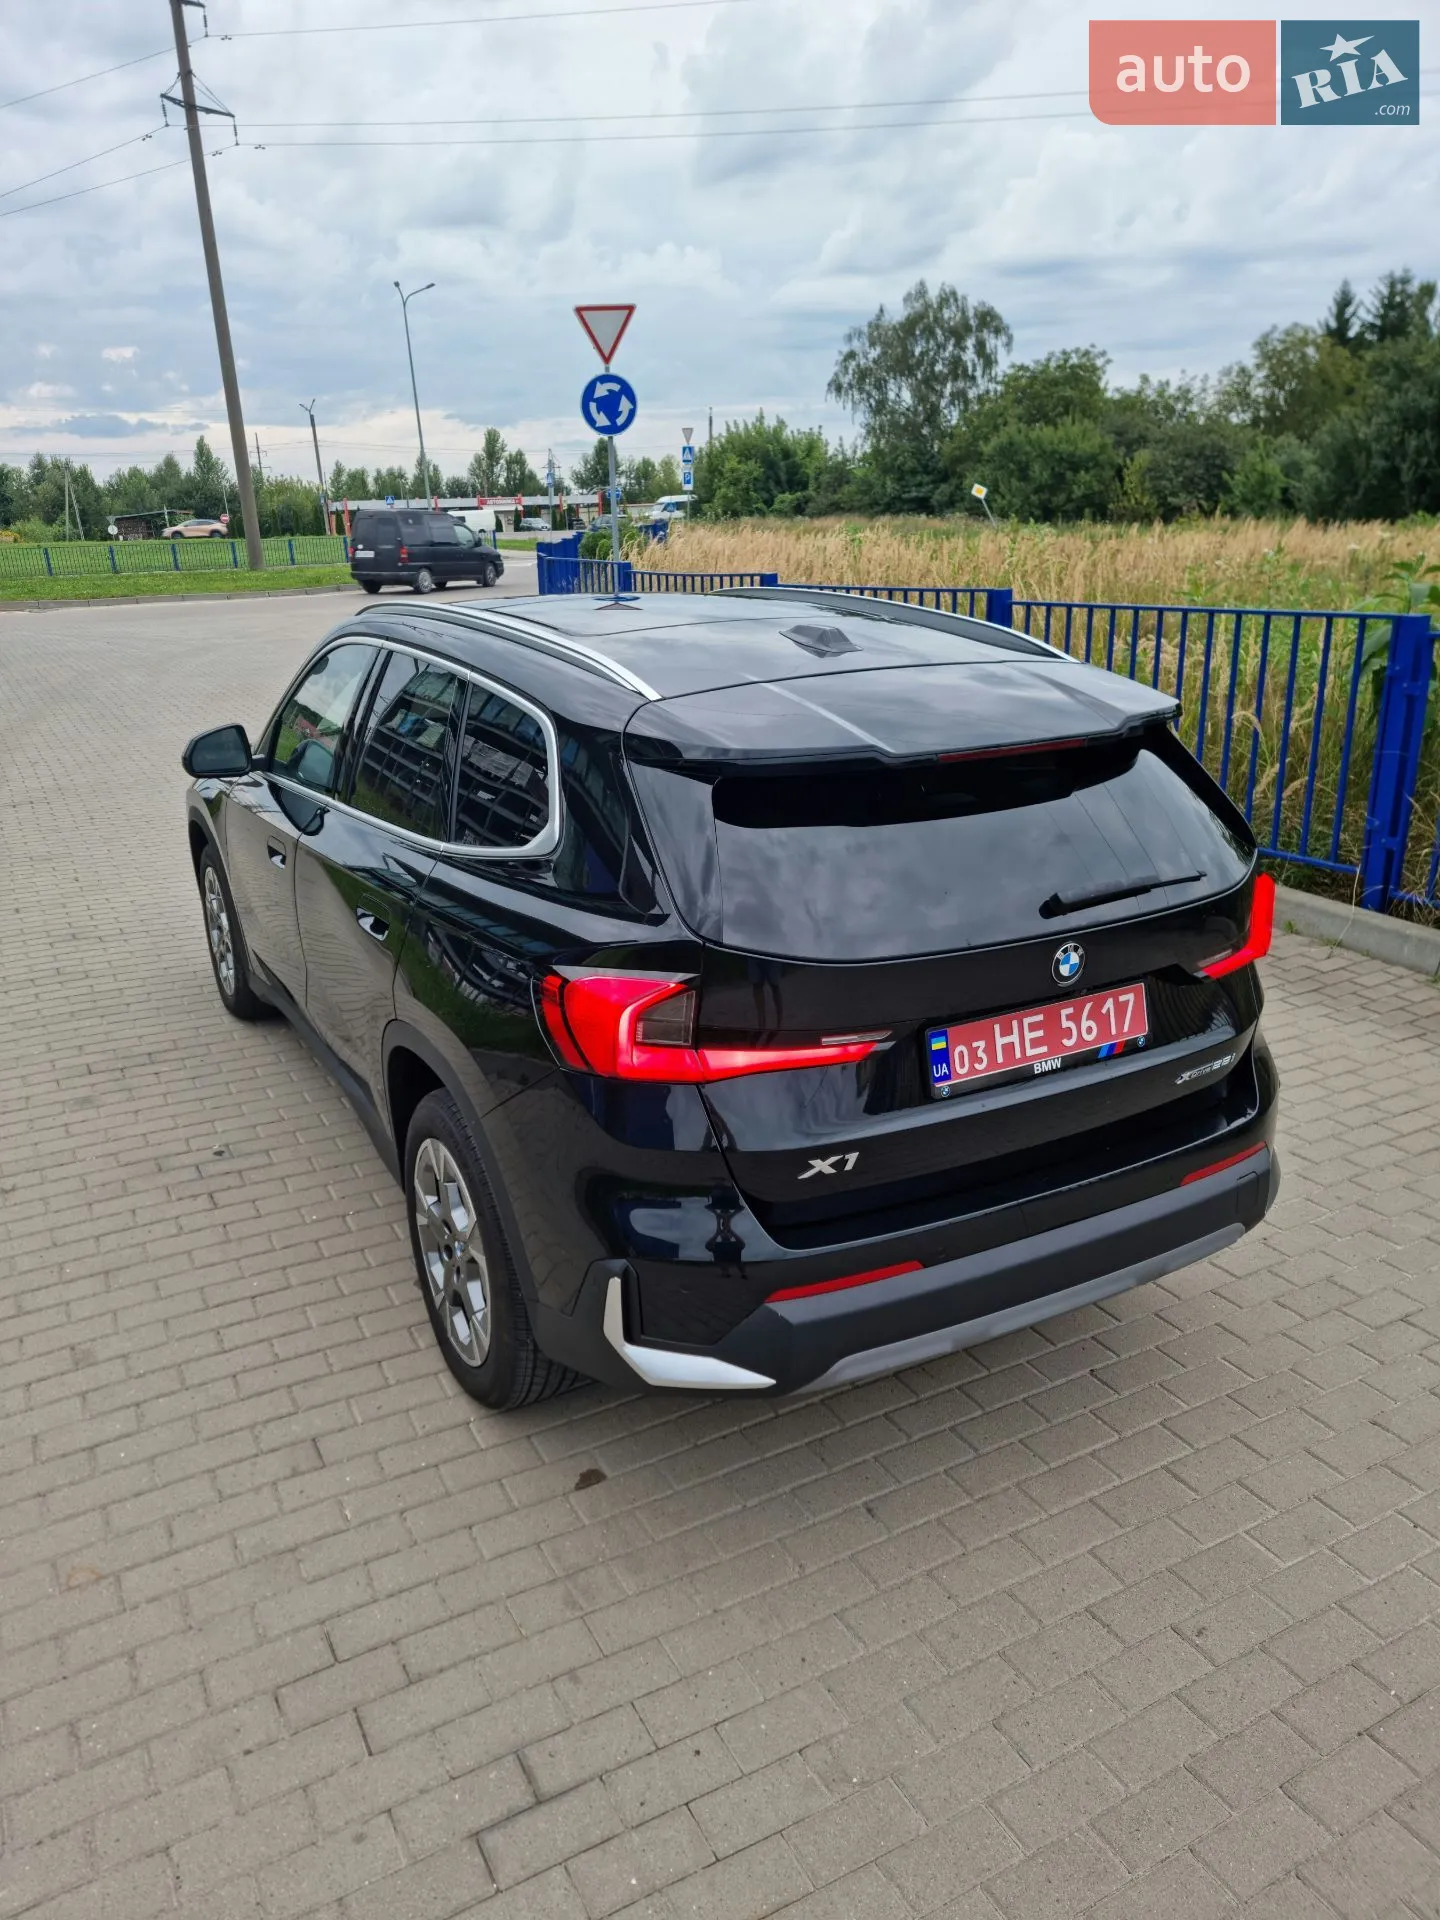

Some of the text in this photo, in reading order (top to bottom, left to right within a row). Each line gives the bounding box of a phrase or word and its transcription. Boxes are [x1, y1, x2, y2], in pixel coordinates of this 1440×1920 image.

[953, 992, 1135, 1075] 03 HE 5617
[933, 1063, 950, 1078] UA
[1033, 1057, 1062, 1075] BMW
[797, 1151, 860, 1180] X1
